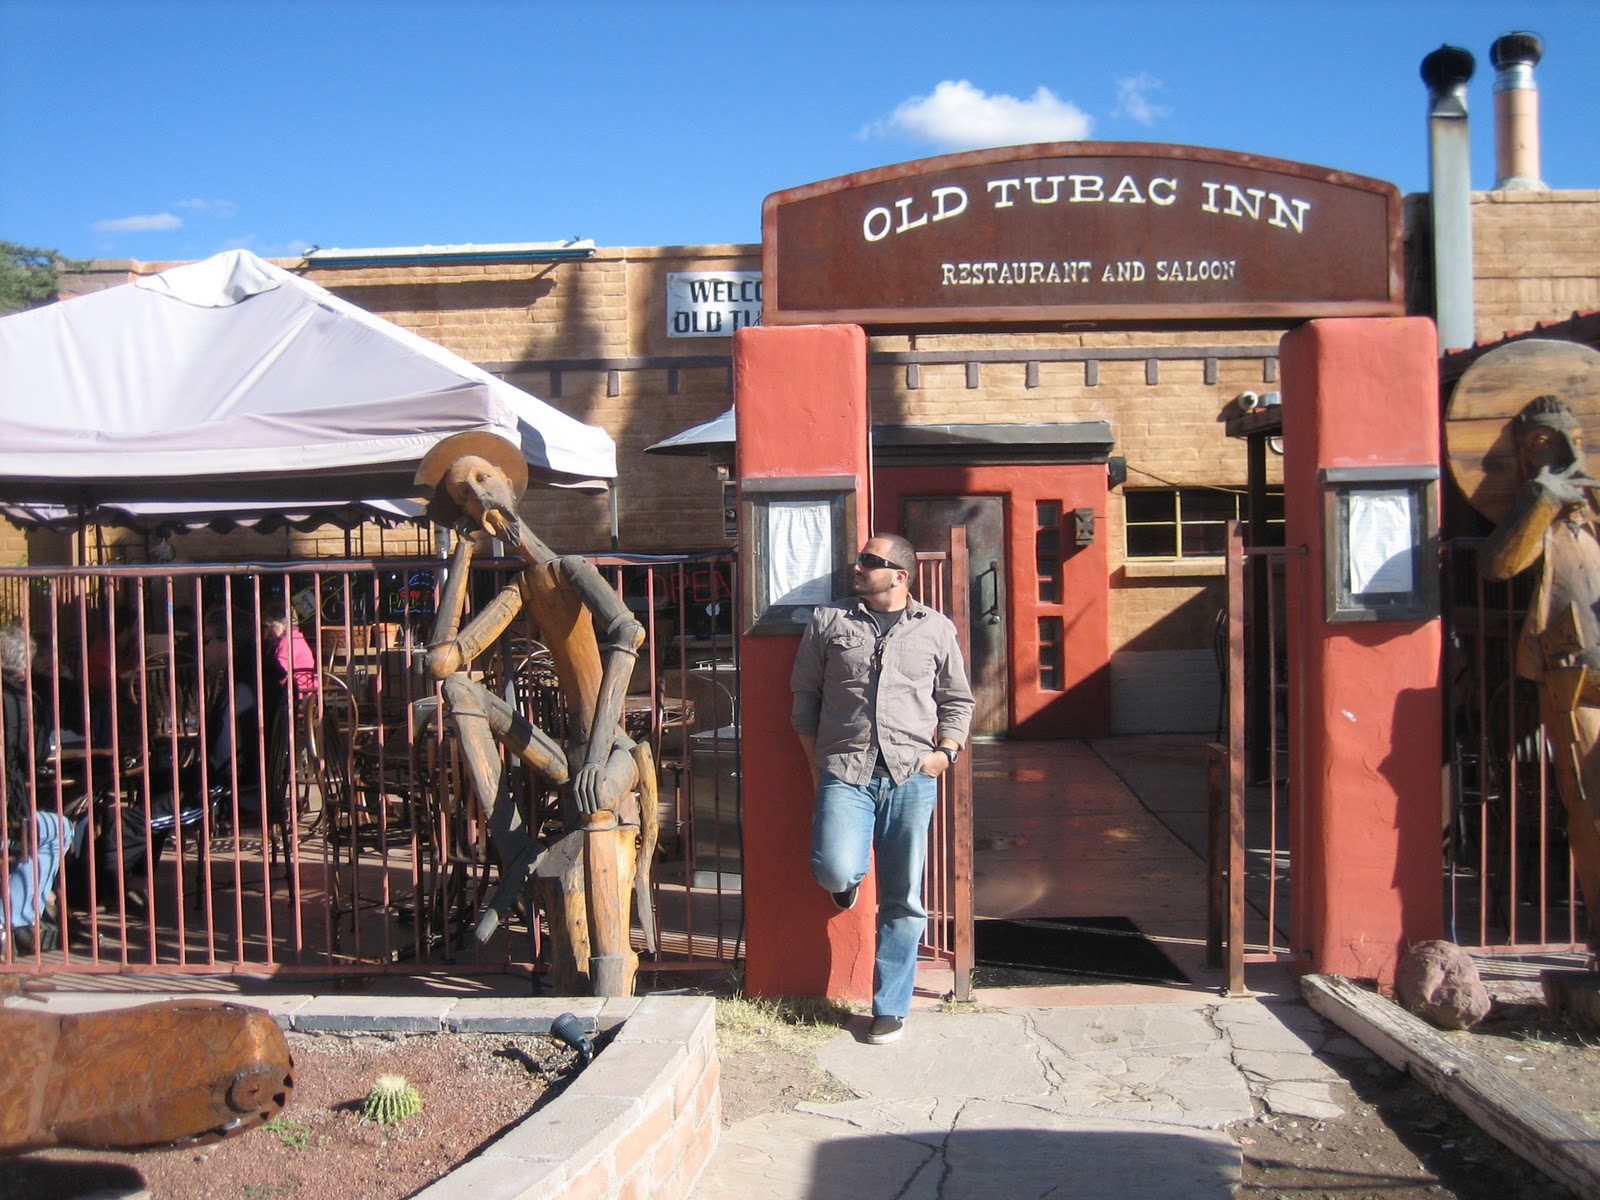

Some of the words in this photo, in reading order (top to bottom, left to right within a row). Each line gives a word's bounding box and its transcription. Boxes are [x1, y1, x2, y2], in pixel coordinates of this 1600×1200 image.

[863, 186, 969, 243] OLD
[986, 175, 1178, 209] TUBAC
[1201, 181, 1312, 234] INN
[941, 260, 1092, 285] RESTAURANT
[1101, 261, 1146, 283] AND
[1156, 259, 1237, 283] SALOON
[674, 310, 722, 333] OLD
[644, 569, 733, 607] OPEN
